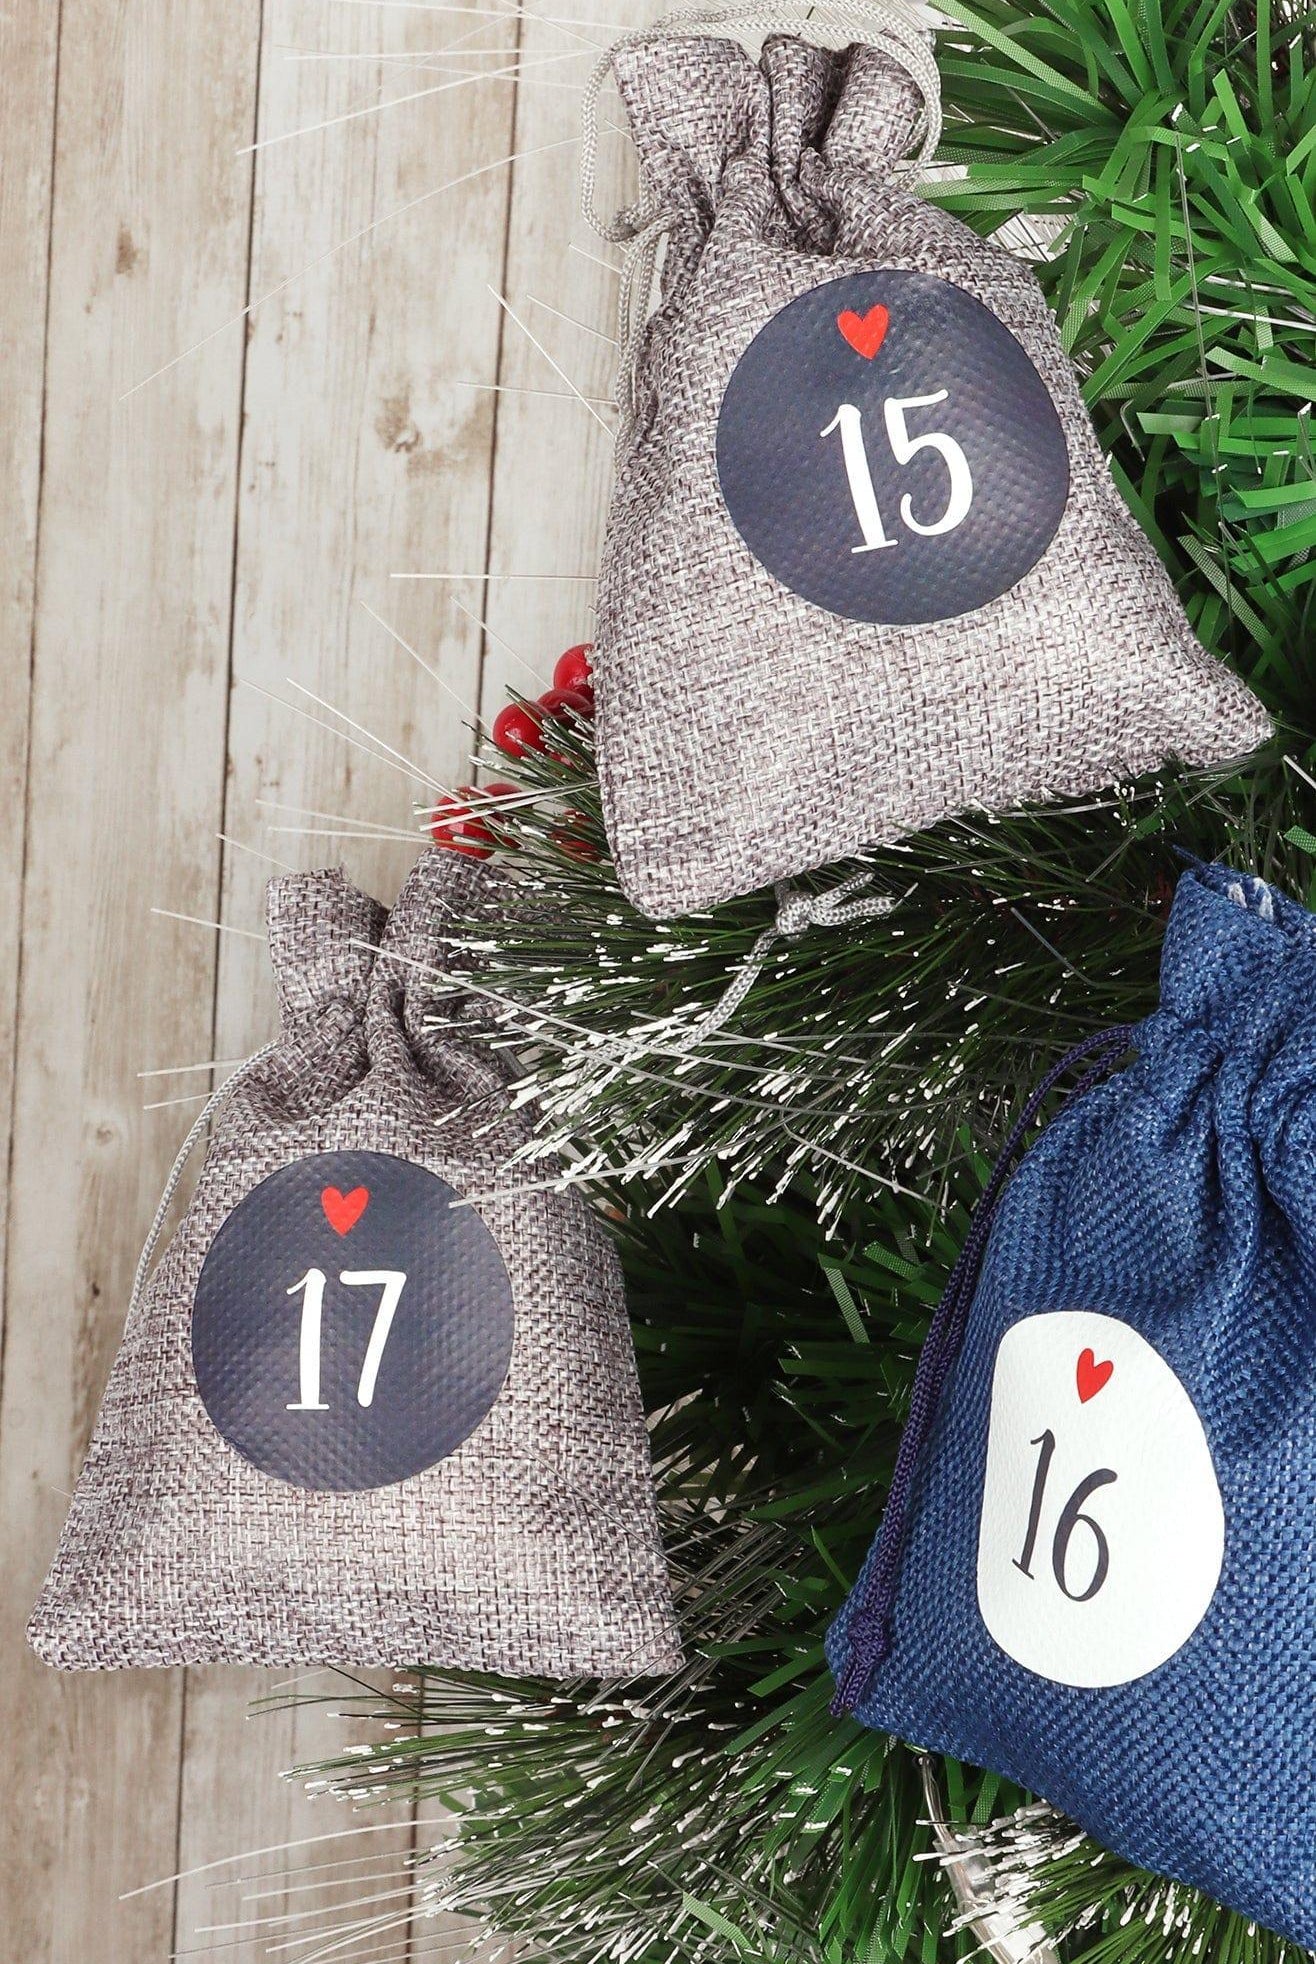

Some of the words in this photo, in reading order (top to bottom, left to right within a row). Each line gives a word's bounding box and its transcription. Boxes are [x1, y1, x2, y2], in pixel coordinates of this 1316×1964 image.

[819, 388, 973, 554] 15
[285, 1268, 407, 1410] 17
[1011, 1428, 1118, 1602] 16
